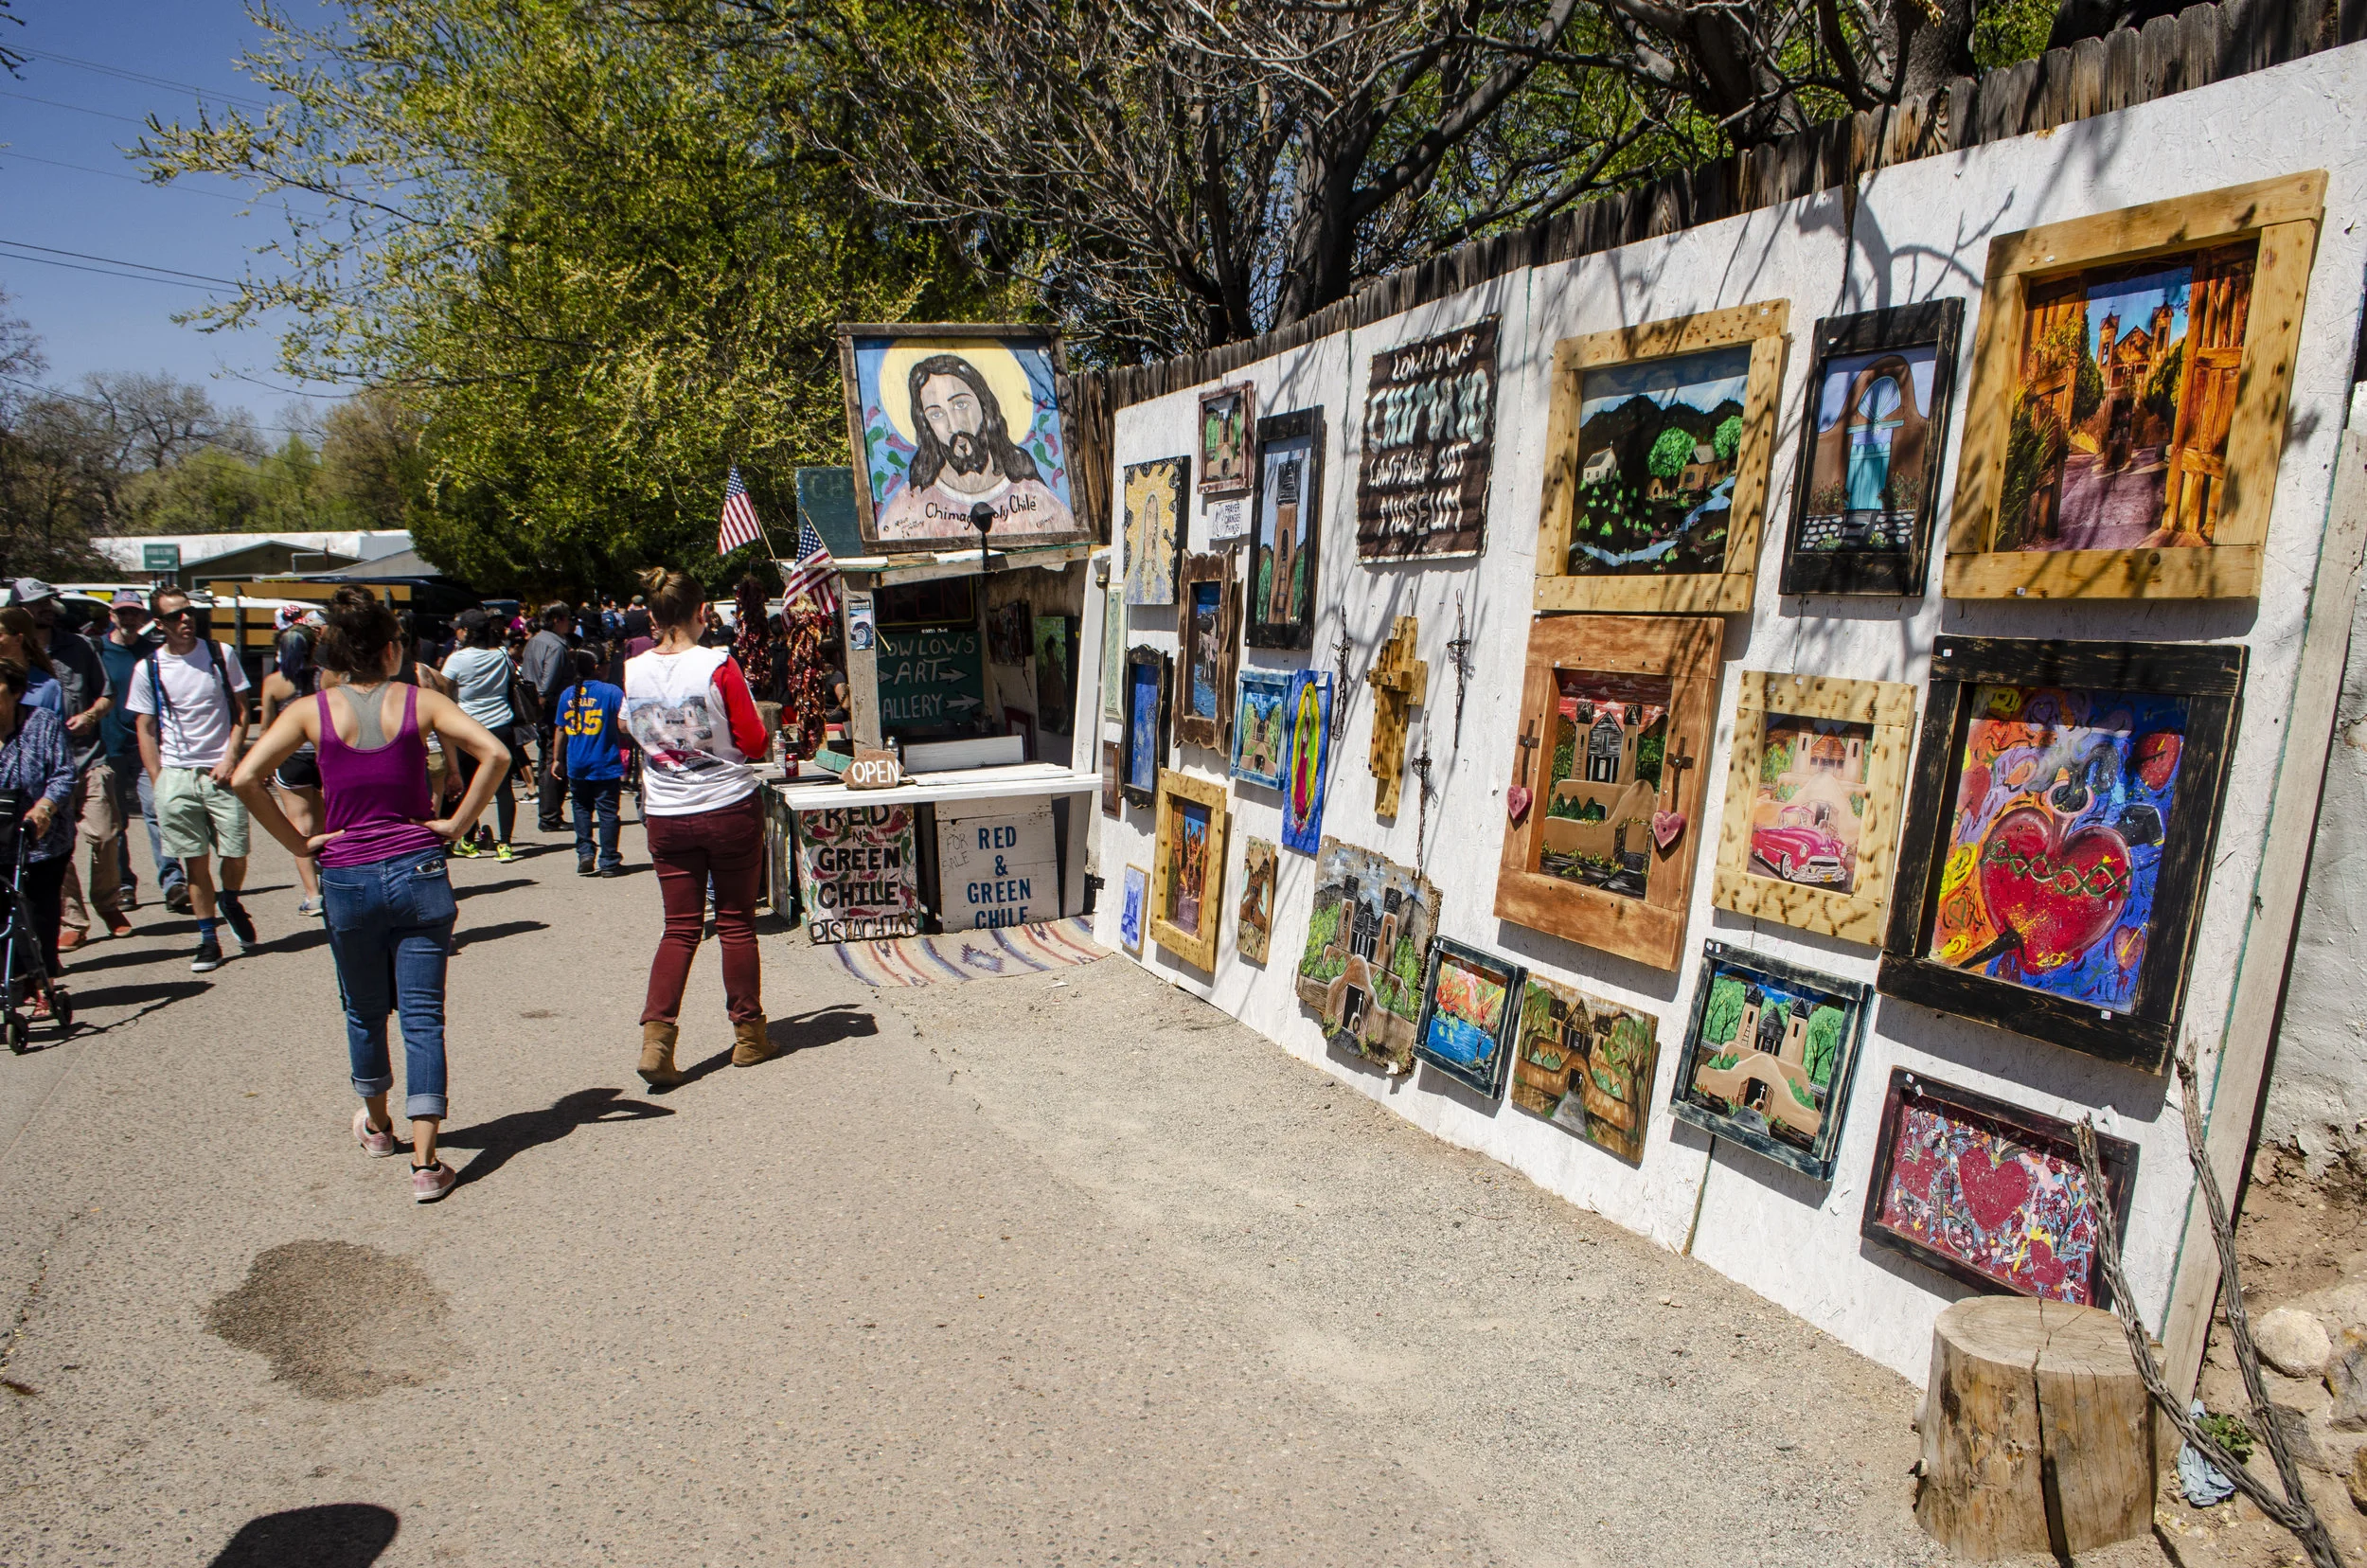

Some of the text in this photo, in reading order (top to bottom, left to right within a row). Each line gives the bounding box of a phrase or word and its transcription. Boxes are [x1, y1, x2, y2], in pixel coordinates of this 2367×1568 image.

[1367, 367, 1489, 454] CHIMAYO
[1433, 442, 1469, 479] ART
[1378, 484, 1463, 537] MUSEUM
[893, 657, 952, 686] ART
[881, 692, 943, 722] ALLERY
[563, 708, 603, 736] 35
[851, 759, 899, 783] OPEN
[946, 833, 969, 852] FOR
[978, 826, 1017, 849] RED
[818, 846, 900, 872] GREEN
[942, 851, 970, 872] SALE
[994, 854, 1008, 877] &
[968, 878, 1032, 904] GREEN
